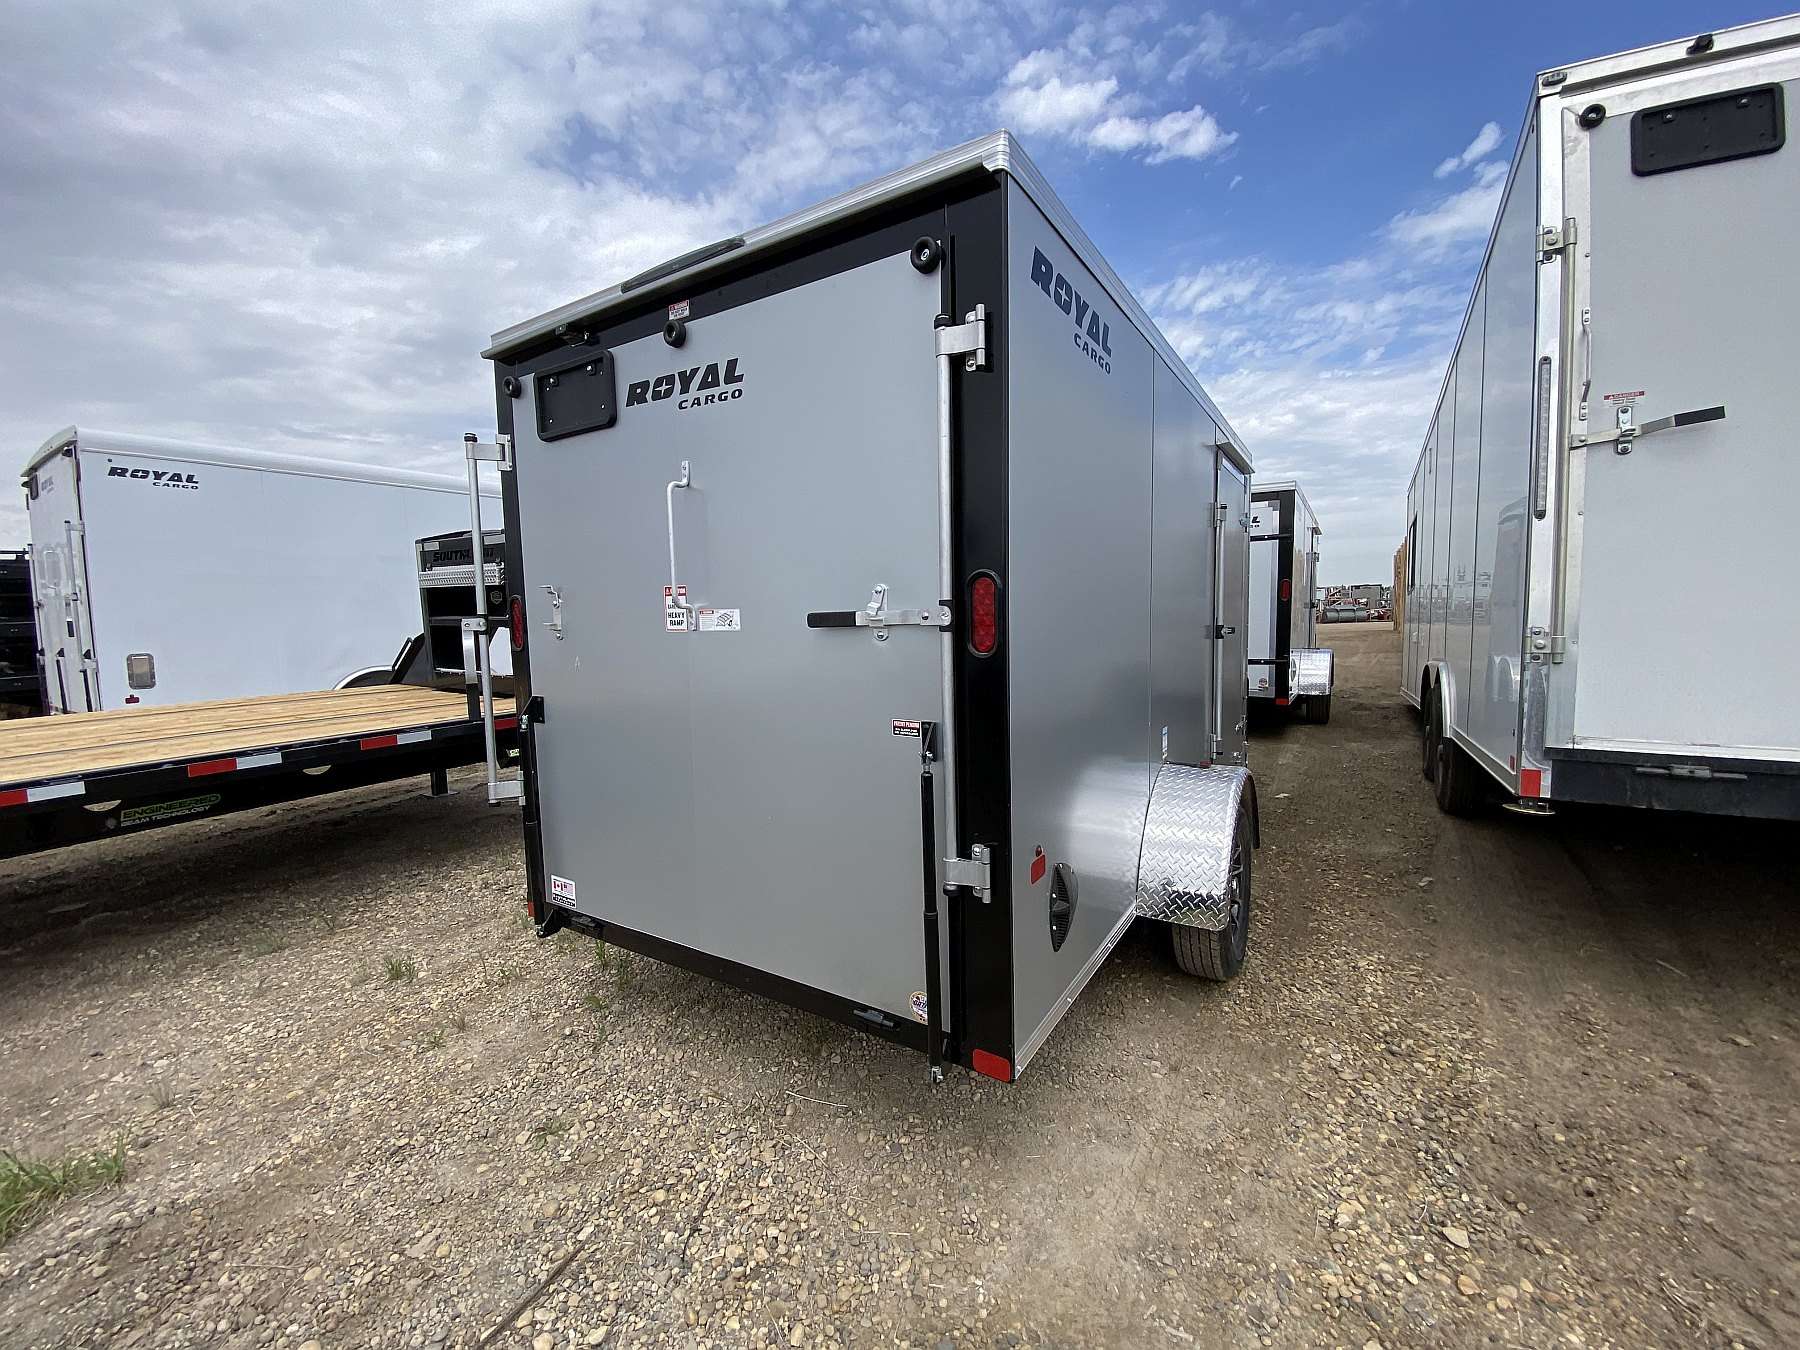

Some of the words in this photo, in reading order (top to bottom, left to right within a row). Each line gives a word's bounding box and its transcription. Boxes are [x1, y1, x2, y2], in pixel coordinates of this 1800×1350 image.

[1030, 245, 1112, 358] ROYAL
[1073, 332, 1111, 375] CARGO
[625, 357, 745, 407] ROYAL
[678, 388, 743, 410] CARGO
[108, 466, 200, 484] ROYAL
[152, 481, 199, 490] CARGO
[667, 611, 685, 619] HEAVY
[669, 619, 685, 627] RAMP
[122, 794, 220, 820] ENGINEERED
[151, 805, 211, 821] TECHNOLOGY
